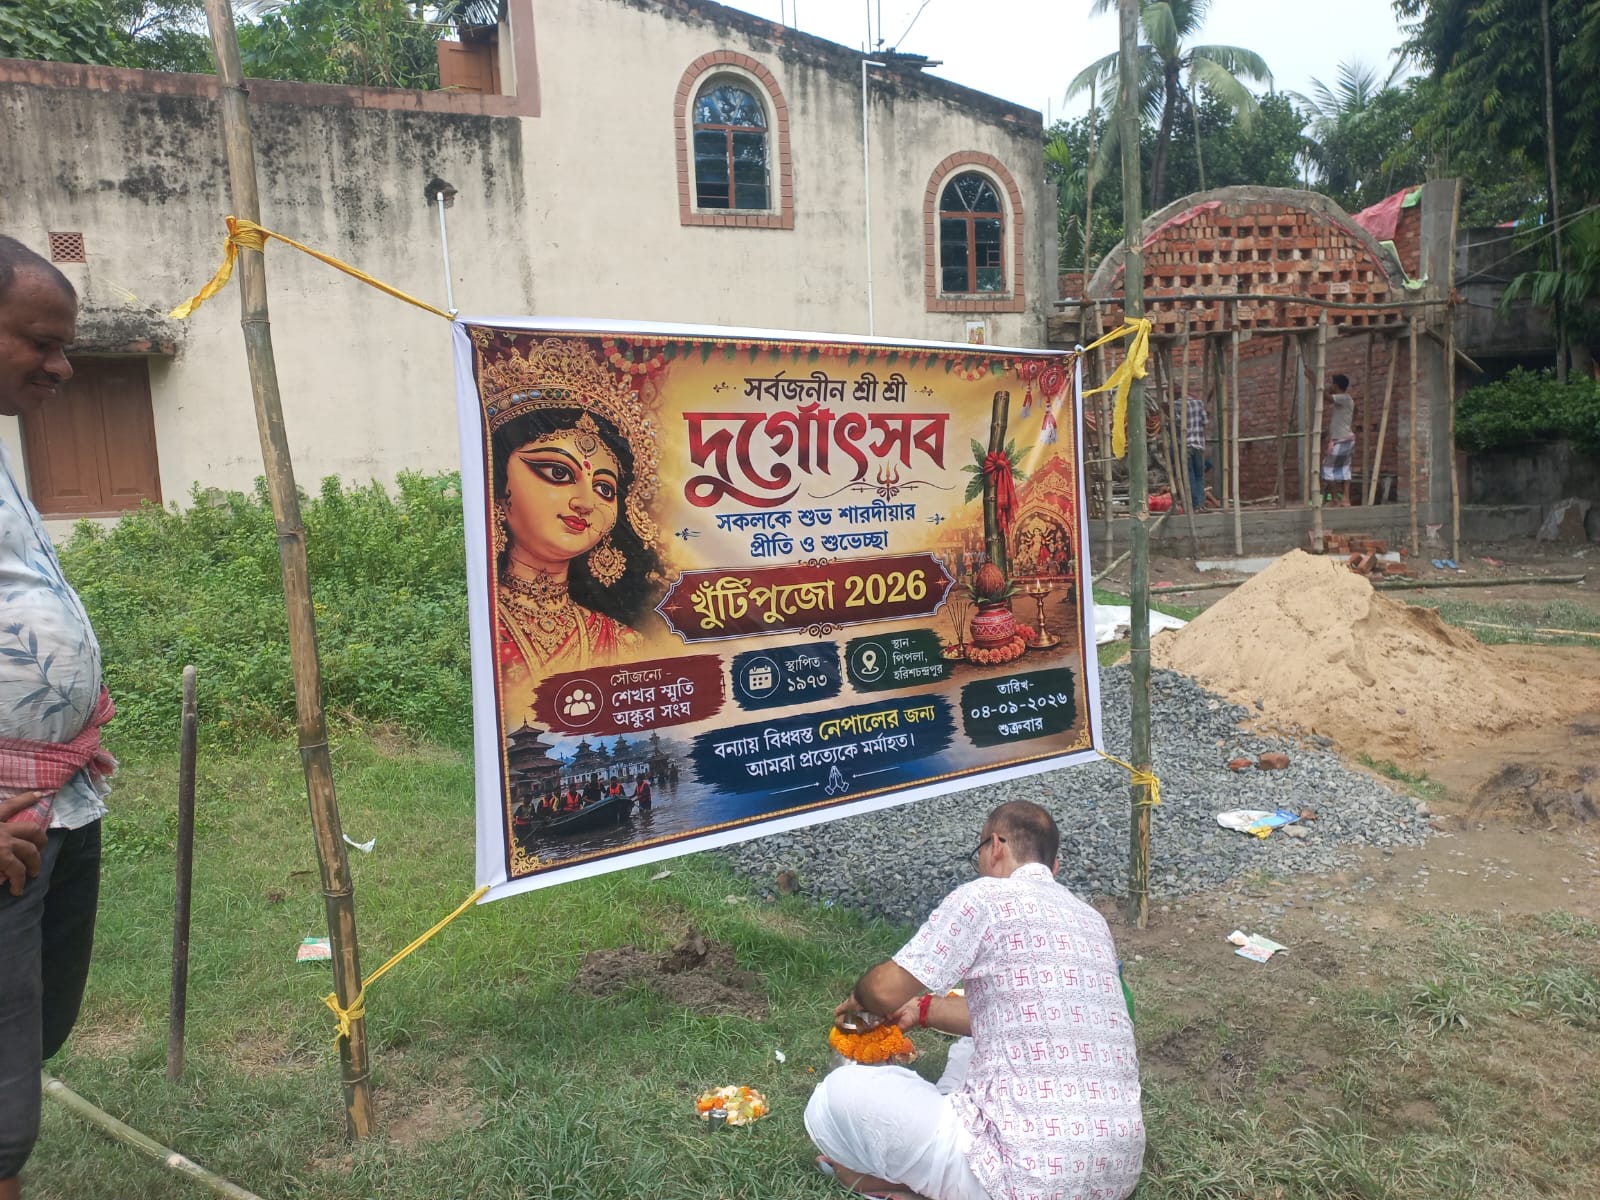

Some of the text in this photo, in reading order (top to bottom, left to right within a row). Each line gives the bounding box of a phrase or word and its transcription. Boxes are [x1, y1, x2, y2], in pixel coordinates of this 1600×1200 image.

[744, 370, 909, 403] সর্বজনীন শ্রী শ্রী
[682, 401, 950, 508] দুর্গোৎসব
[715, 498, 916, 532] সকলকে শুভ শারদীয়ার
[750, 530, 888, 558] প্রীতি ও শুভেচ্ছা
[844, 569, 927, 608] 2026
[891, 637, 909, 650] স্থান
[784, 654, 821, 673] স্থাপিত
[610, 668, 662, 687] সৌজন্যে
[787, 673, 828, 692] ১৯৭৩
[612, 687, 656, 707] শেখর
[971, 692, 1068, 719] ০৪-০৯-২০২৬
[613, 701, 691, 728] অঙ্কুর সংঘ
[998, 717, 1044, 736] শুক্রবার
[713, 736, 760, 759] বন্যায়
[818, 708, 899, 741] নেপালের
[903, 704, 936, 725] জন্য
[745, 754, 795, 778] আমরা
[799, 742, 858, 768] প্রত্যেকে
